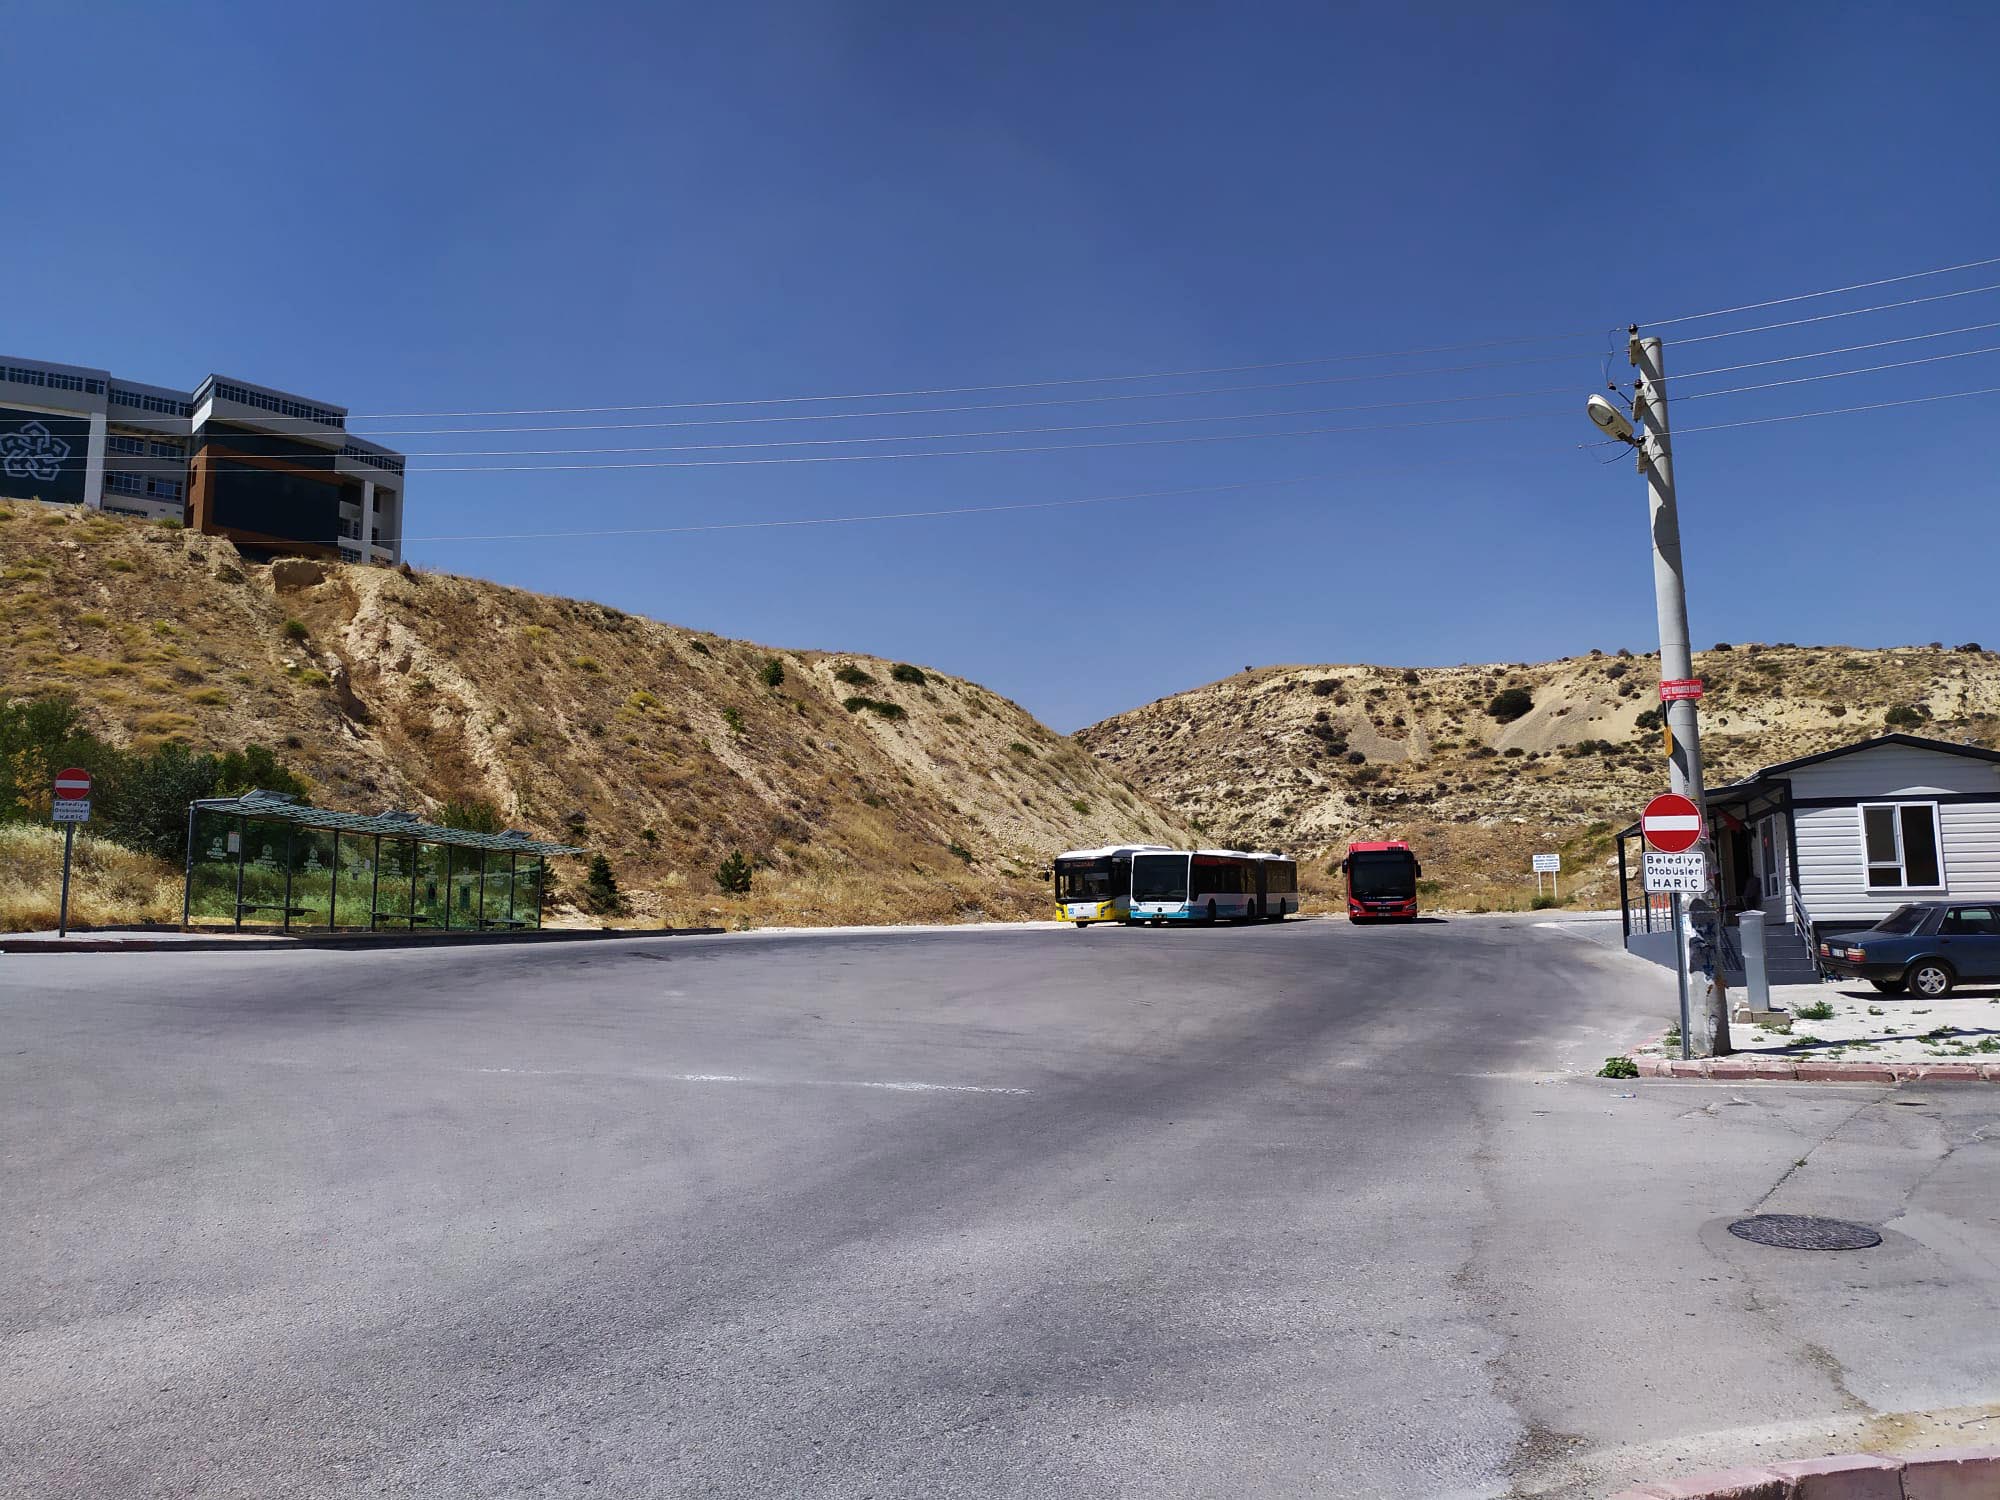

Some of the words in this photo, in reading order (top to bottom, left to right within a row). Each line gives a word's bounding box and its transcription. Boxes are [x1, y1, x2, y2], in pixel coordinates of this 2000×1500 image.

[1647, 855, 1701, 866] Belediye
[1647, 867, 1703, 875] Otobüsleri
[1653, 877, 1698, 889] HARİÇ
